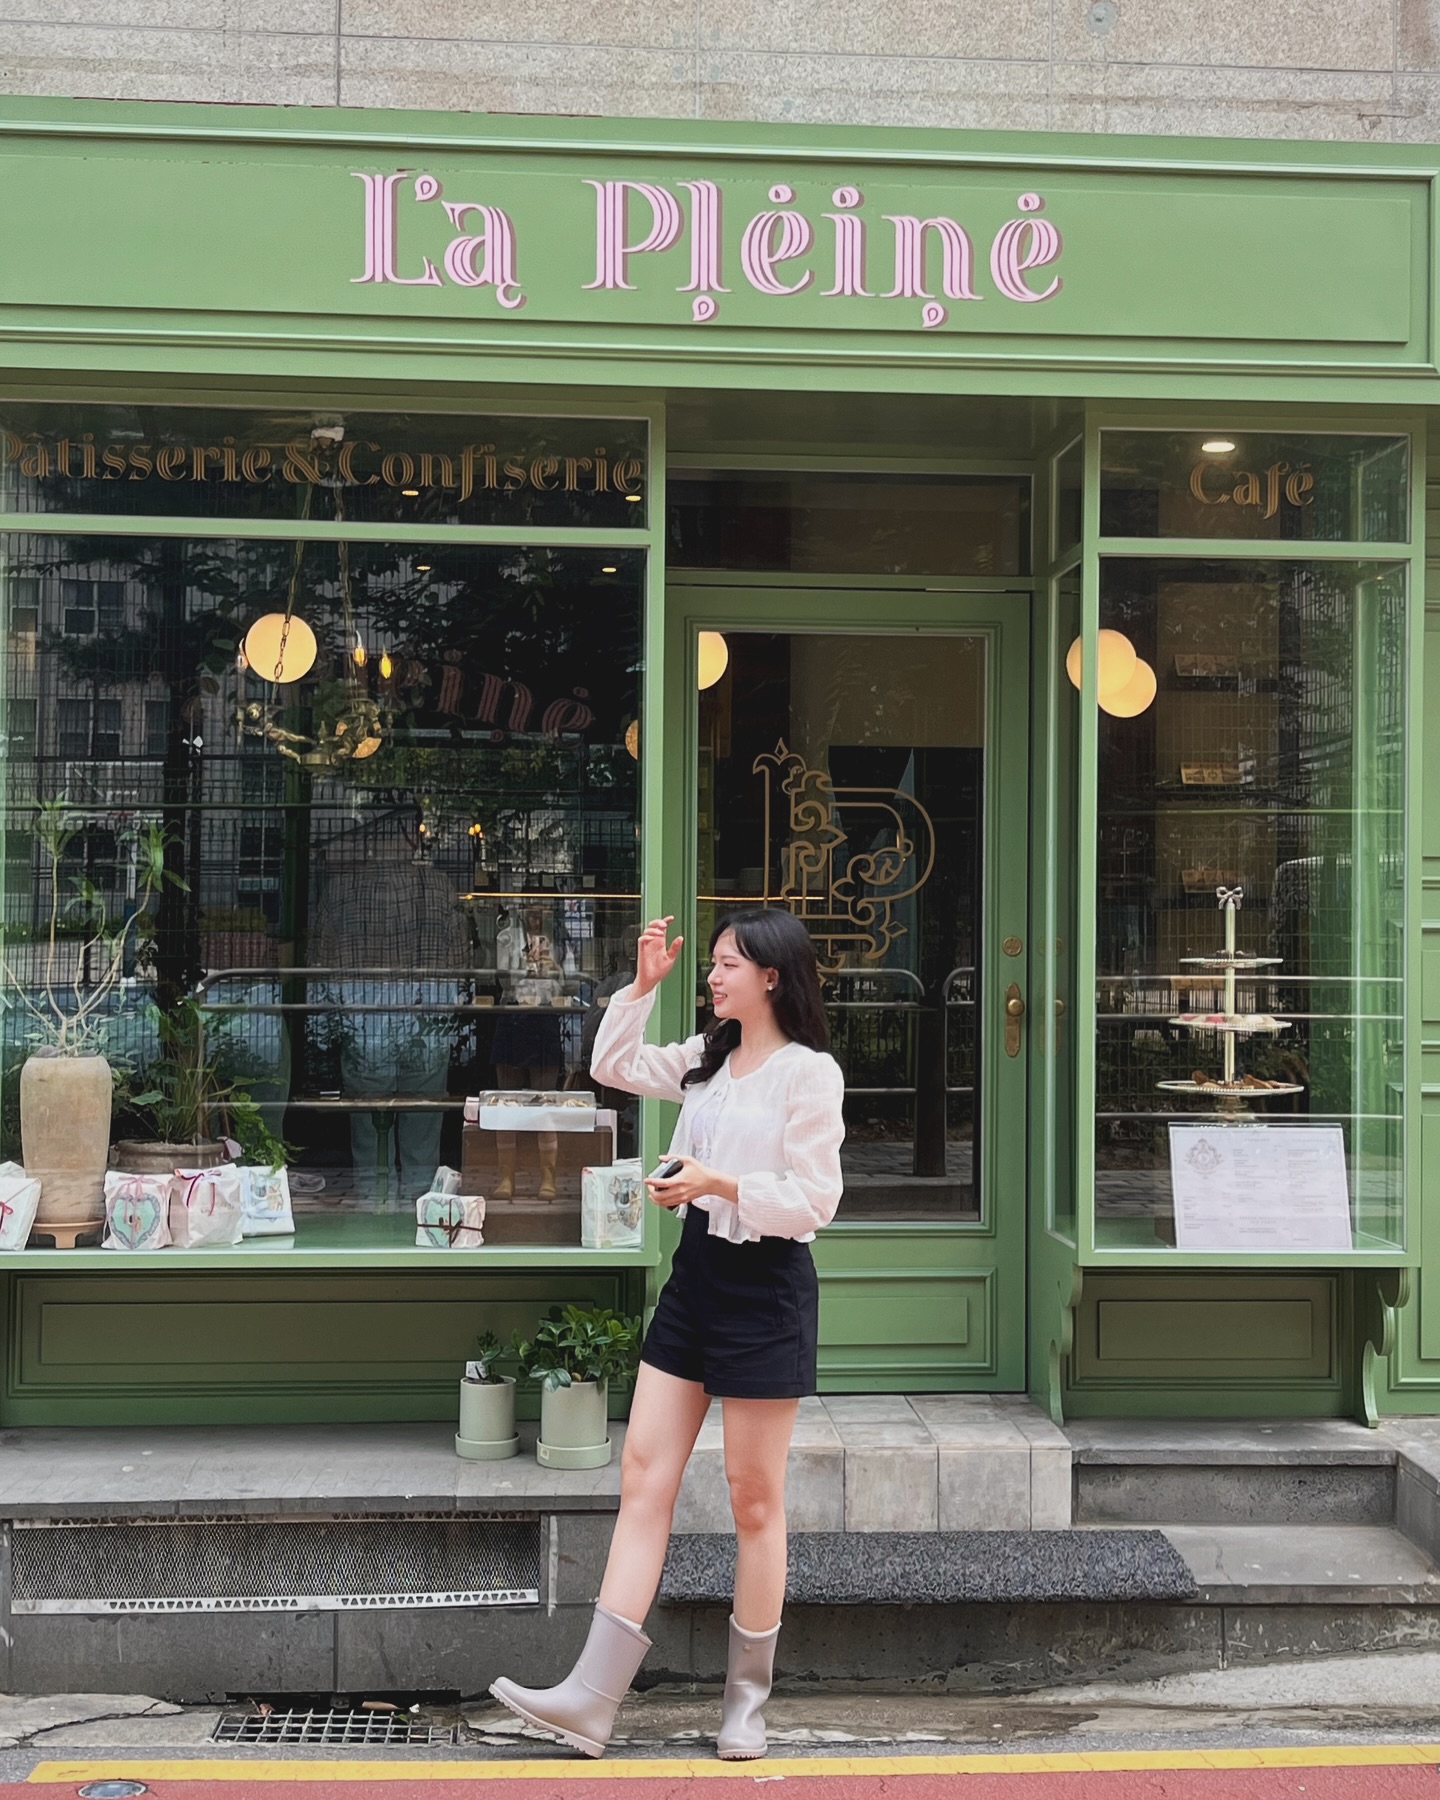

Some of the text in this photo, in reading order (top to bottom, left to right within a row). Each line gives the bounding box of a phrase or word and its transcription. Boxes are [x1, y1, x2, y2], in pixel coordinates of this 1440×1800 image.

[351, 171, 1064, 328] La Pleine
[338, 441, 642, 502] Confiserie
[1189, 460, 1315, 520] Café
